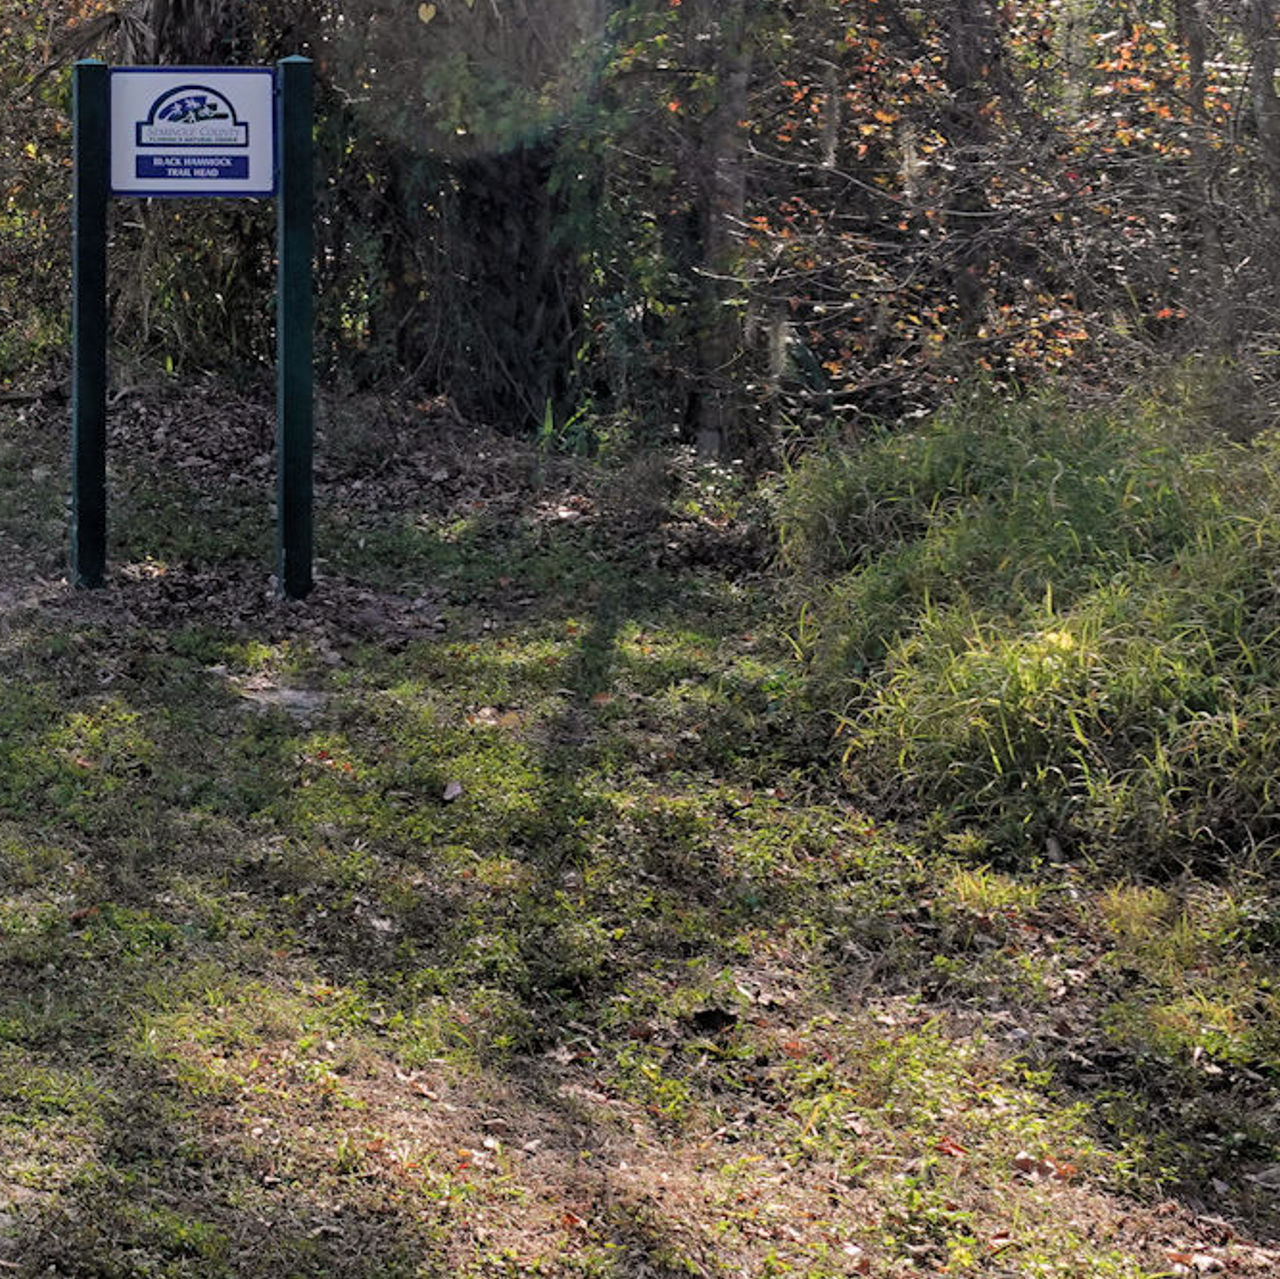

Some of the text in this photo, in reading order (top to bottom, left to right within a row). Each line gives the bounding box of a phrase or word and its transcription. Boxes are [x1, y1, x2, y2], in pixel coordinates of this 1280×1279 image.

[153, 157, 232, 166] BLACK HAMMOCK
[167, 168, 219, 176] TRAIL HEAD
